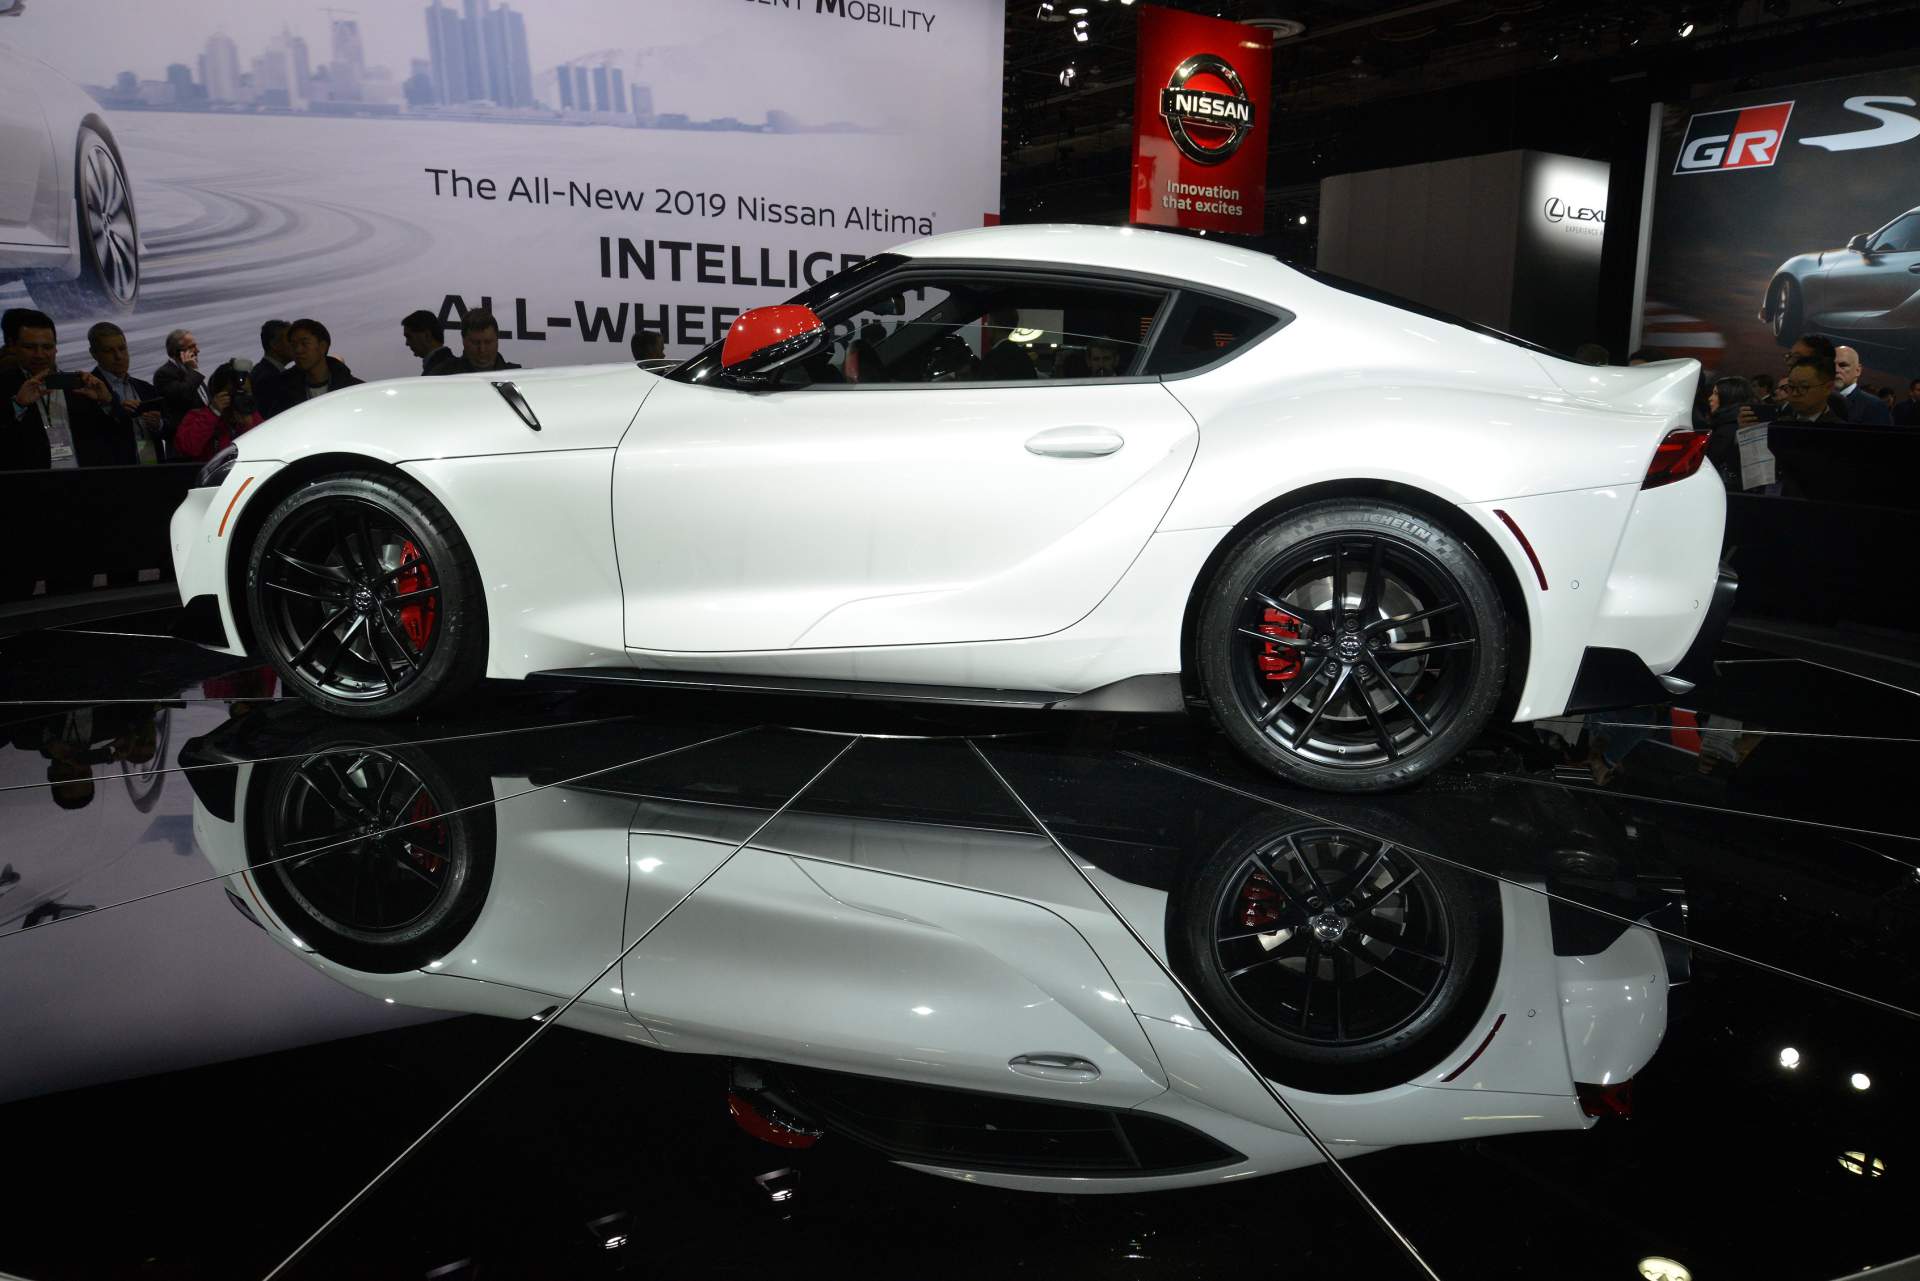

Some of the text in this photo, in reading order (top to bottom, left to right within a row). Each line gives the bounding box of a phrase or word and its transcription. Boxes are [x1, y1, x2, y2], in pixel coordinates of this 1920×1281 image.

[815, 0, 936, 33] MOBILITY
[1175, 93, 1249, 121] NISSAN
[1680, 129, 1779, 170] GR
[424, 167, 933, 237] The All-New 2019 Nissan Altima
[1168, 180, 1239, 199] Innovation
[1162, 197, 1242, 215] that excites
[435, 295, 752, 346] AL-WHEE
[1350, 512, 1431, 539] MICHELIN
